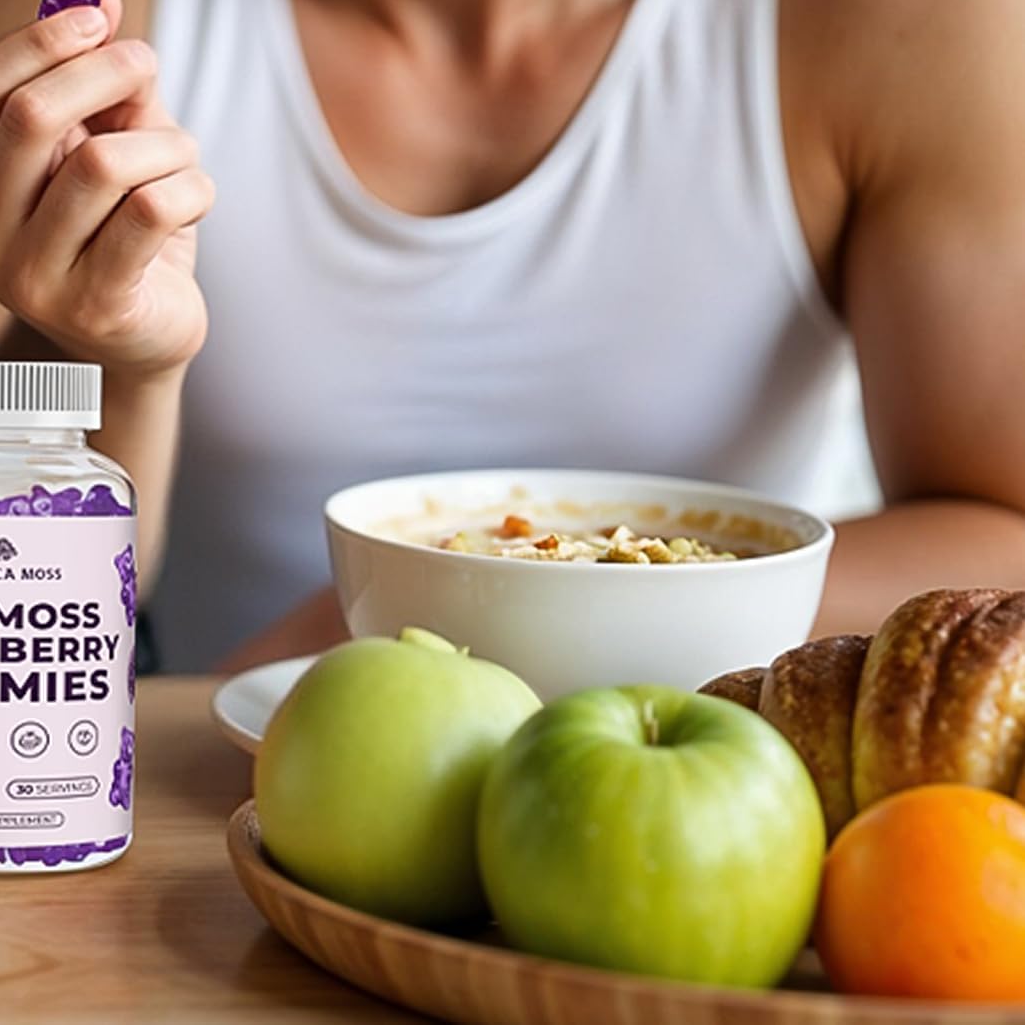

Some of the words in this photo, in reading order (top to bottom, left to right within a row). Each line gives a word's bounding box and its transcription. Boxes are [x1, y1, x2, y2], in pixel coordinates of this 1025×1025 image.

[20, 567, 63, 581] MOSS
[16, 784, 34, 796] 30
[35, 780, 94, 795] SERVINGS
